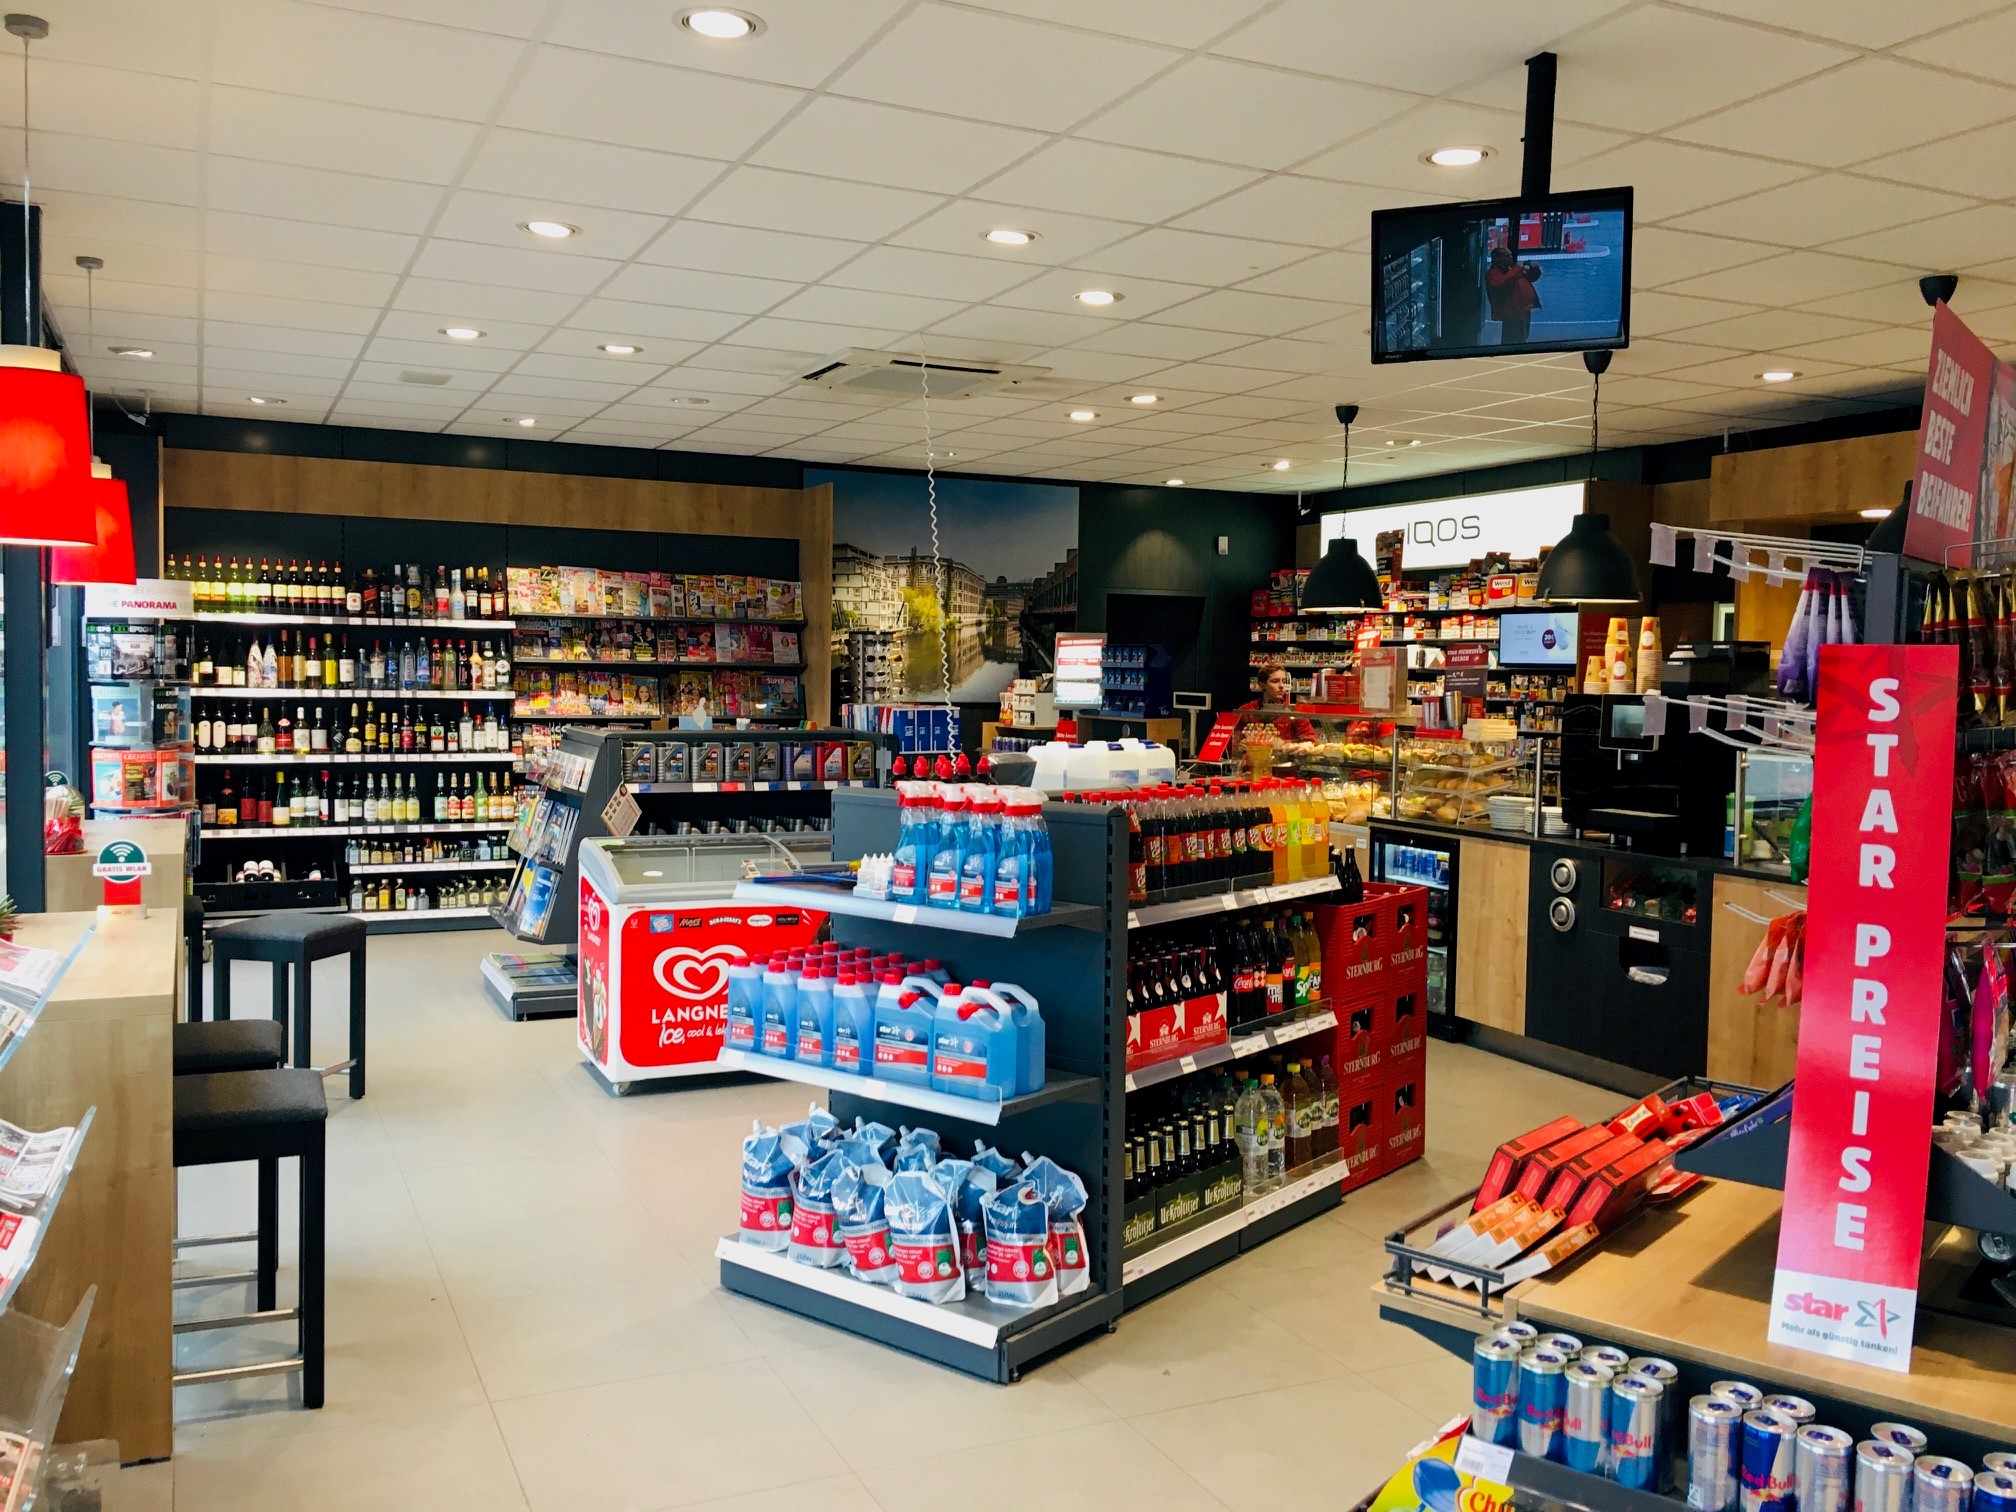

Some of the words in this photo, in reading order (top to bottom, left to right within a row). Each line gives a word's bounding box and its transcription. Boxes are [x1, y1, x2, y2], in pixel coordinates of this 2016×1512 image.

[1932, 348, 1974, 417] ZIEMLICH
[1924, 409, 1956, 466] BESTE
[1916, 470, 1973, 532] BEIFAHRER!
[1407, 515, 1480, 547] IQOS
[1493, 579, 1511, 587] West
[121, 600, 177, 610] PANORAMA
[1858, 676, 1901, 890] STAR
[1391, 945, 1424, 967] STERNBURG
[1346, 957, 1383, 980] STERNBURG
[1295, 980, 1310, 998] Sp
[651, 1003, 728, 1025] LANGNE
[706, 1025, 713, 1037] &
[1149, 1032, 1179, 1049] STERNBURG
[1390, 1034, 1422, 1057] STERNBURG
[1343, 1051, 1381, 1075] STERNBURG
[1833, 923, 1892, 1252] PREISE
[1389, 1124, 1422, 1150] STERNBURG
[1347, 1145, 1379, 1170] TERNBURG
[1784, 1292, 1849, 1322] star
[1781, 1321, 1805, 1333] Mehr
[1807, 1327, 1820, 1337] als
[1822, 1331, 1859, 1347] günstig
[1861, 1340, 1898, 1355] tanken!
[1741, 1464, 1765, 1488] Red
